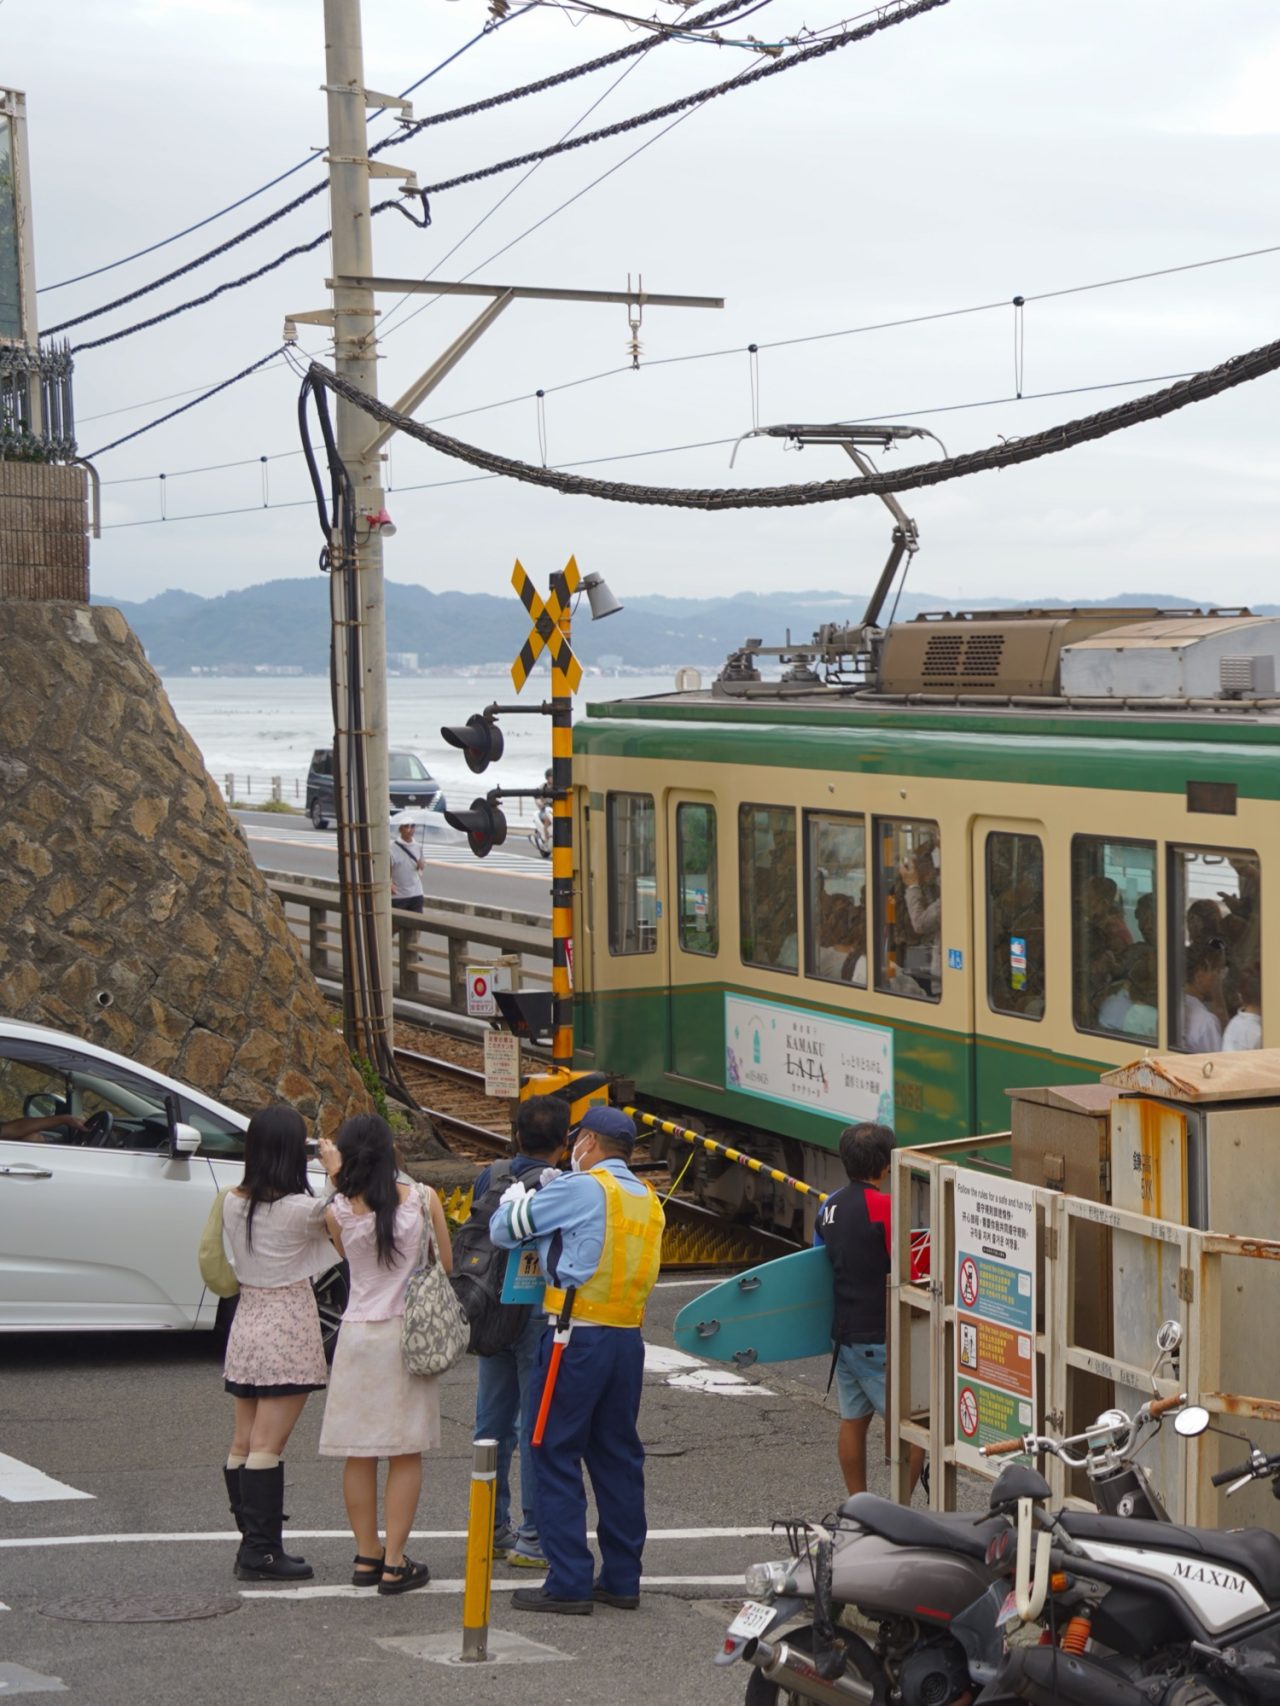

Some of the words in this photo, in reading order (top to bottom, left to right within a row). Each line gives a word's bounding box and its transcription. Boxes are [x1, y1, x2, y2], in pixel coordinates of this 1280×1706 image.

[786, 1034, 825, 1057] KAMAKU
[785, 1052, 827, 1084] LATA
[957, 1183, 971, 1195] Follow
[970, 1187, 978, 1197] the
[977, 1190, 988, 1200] rules
[999, 1194, 1008, 1205] safe
[1008, 1197, 1016, 1208] and
[1016, 1199, 1024, 1210] fun
[1024, 1201, 1033, 1214] trip
[822, 1204, 837, 1226] M
[1173, 1561, 1247, 1594] MAXIM
